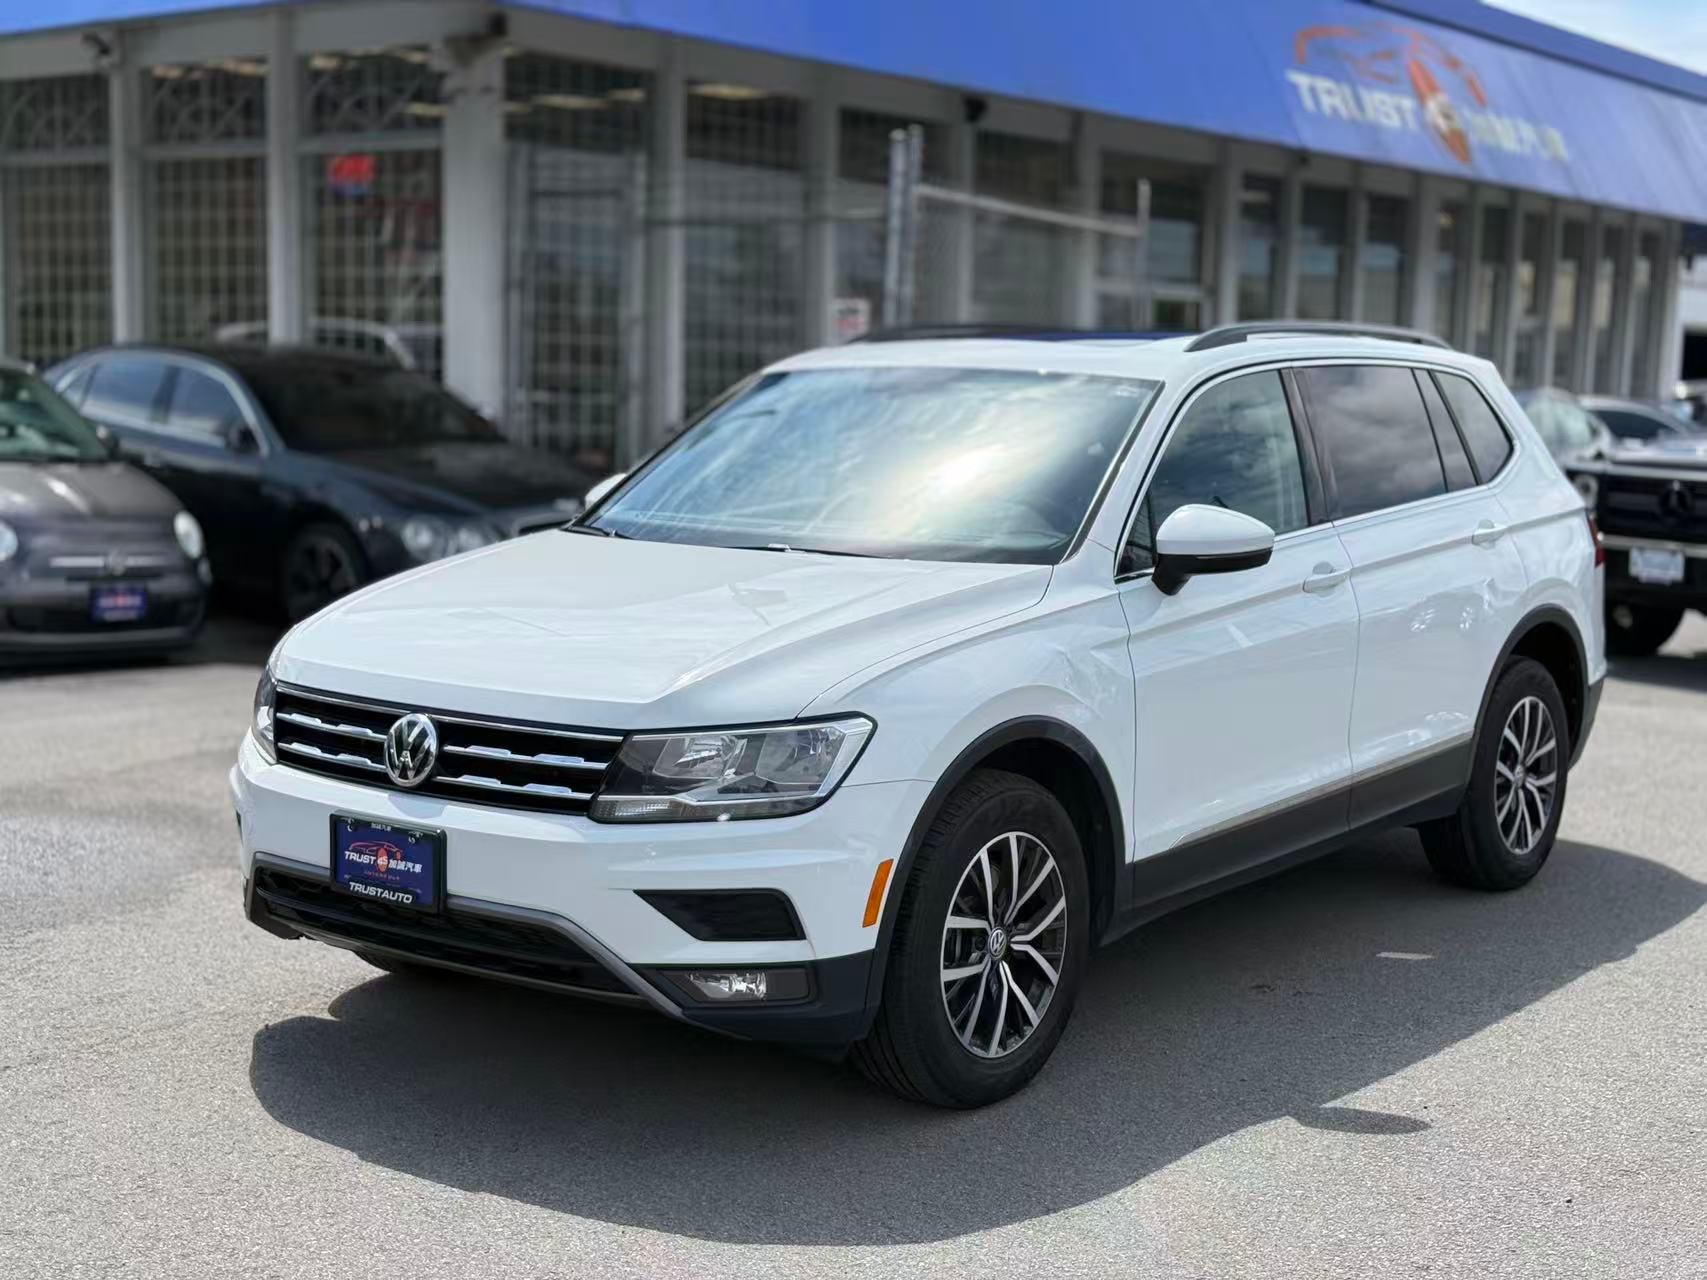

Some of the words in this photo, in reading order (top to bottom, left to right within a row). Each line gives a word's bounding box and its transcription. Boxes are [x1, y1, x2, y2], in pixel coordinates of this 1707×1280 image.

[1286, 71, 1420, 130] TRUST
[344, 851, 377, 865] TRUST
[349, 882, 413, 903] TRUSTAUTO
